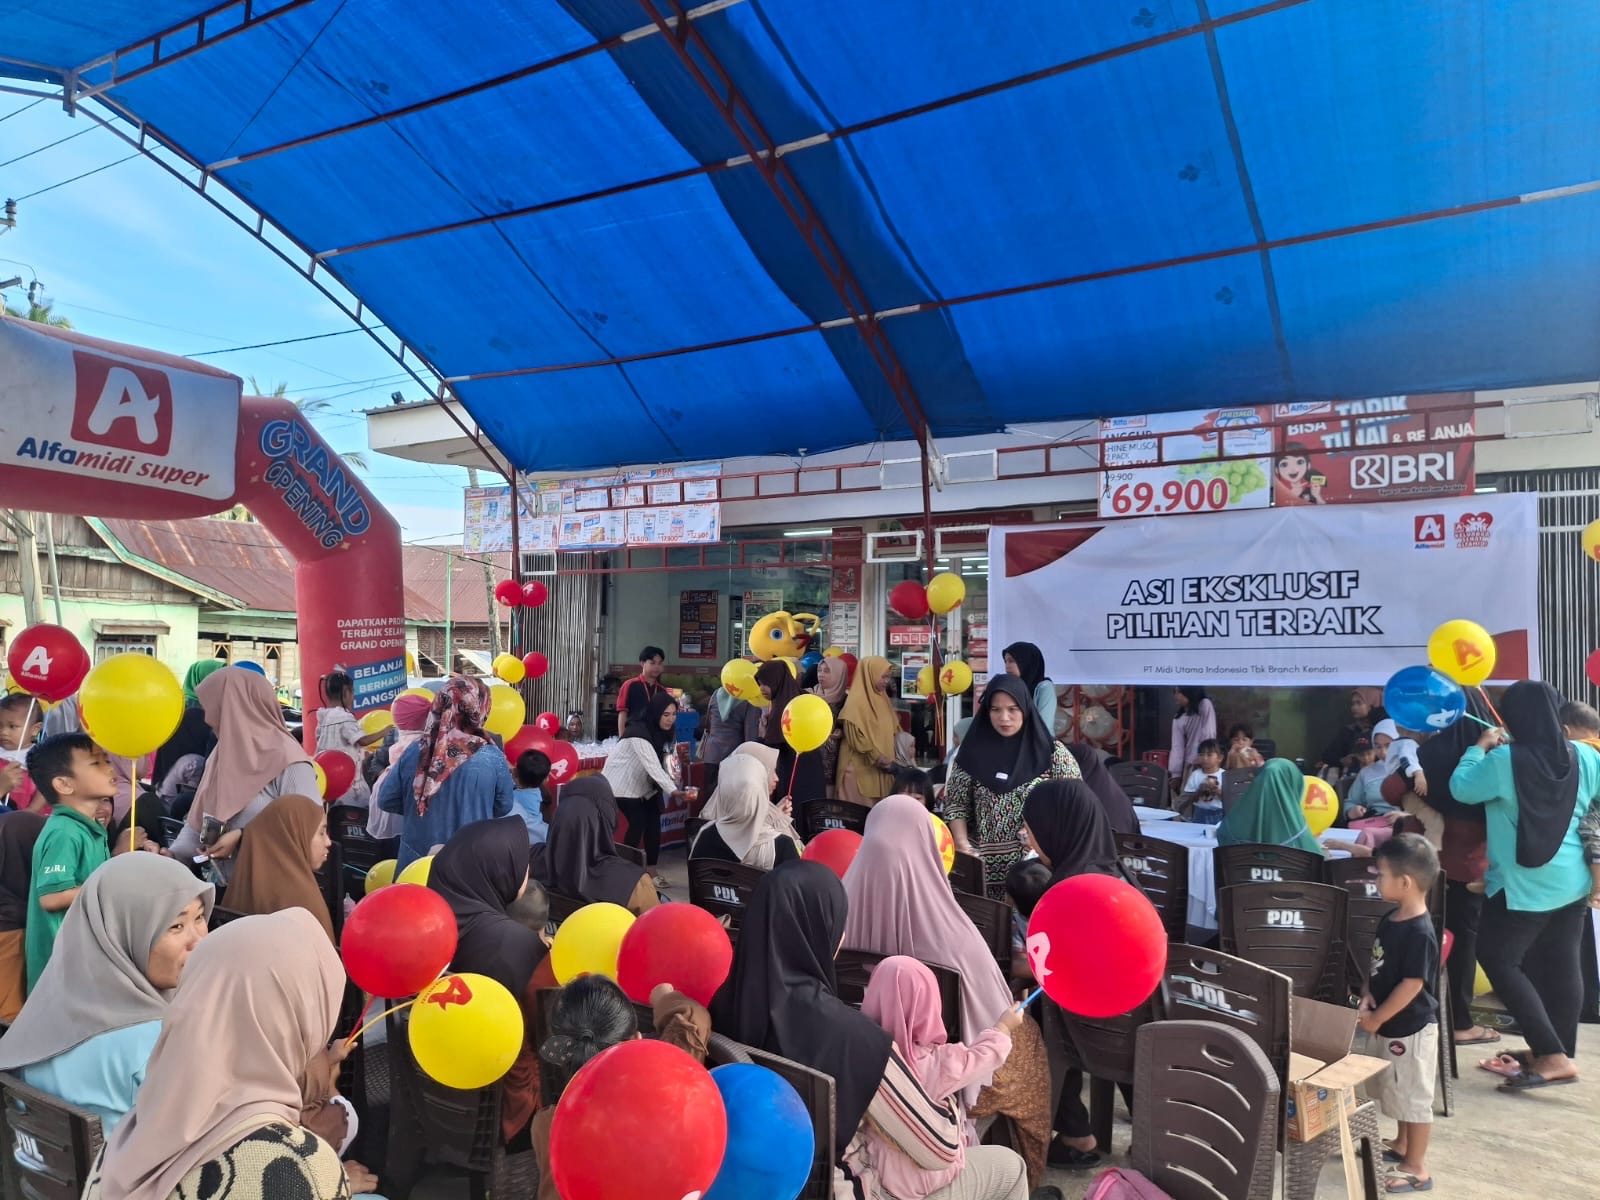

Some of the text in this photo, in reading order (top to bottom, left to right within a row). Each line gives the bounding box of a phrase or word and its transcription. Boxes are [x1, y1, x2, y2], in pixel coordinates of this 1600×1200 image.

[1288, 422, 1328, 436] BISA
[16, 437, 210, 487] Alfamidi super
[1391, 452, 1455, 484] BRI
[260, 419, 371, 535] GRAND
[1113, 478, 1228, 514] 69.900
[264, 461, 344, 549] OPENING
[1121, 570, 1359, 606] ASI EKSKLUSIF
[337, 619, 387, 628] DAPATKAN
[1107, 606, 1384, 639] PILIHAN TERBAIK
[341, 629, 383, 638] TERBAIK
[340, 641, 378, 650] GRAND
[354, 659, 403, 679] BELANJA
[1143, 664, 1339, 674] PT Midi Utama Indonesia Tbk Branch Kendari
[347, 825, 366, 837] PDL
[825, 818, 846, 829] PDL
[44, 864, 66, 874] ZARA
[1123, 857, 1152, 872] PDL
[1251, 867, 1283, 882] PDL
[713, 885, 740, 902] PDL
[1267, 910, 1304, 925] PDL
[1191, 982, 1232, 1010] PDL
